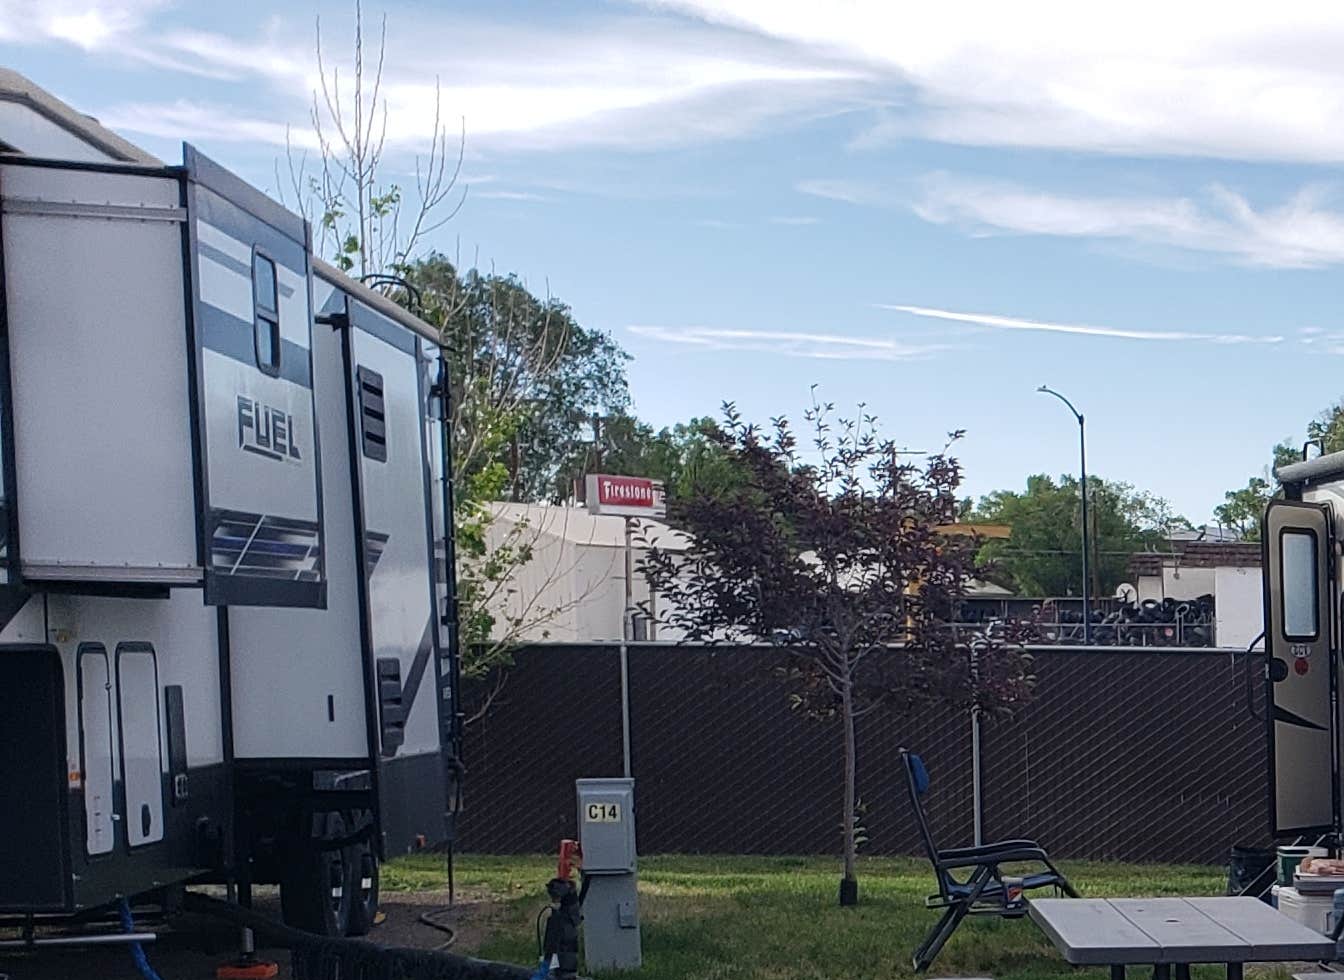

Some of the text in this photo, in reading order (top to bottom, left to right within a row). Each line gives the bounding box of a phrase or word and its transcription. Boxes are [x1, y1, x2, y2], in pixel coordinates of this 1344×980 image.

[236, 393, 302, 461] FUEL
[602, 480, 652, 500] Firestone
[588, 804, 618, 820] C14
